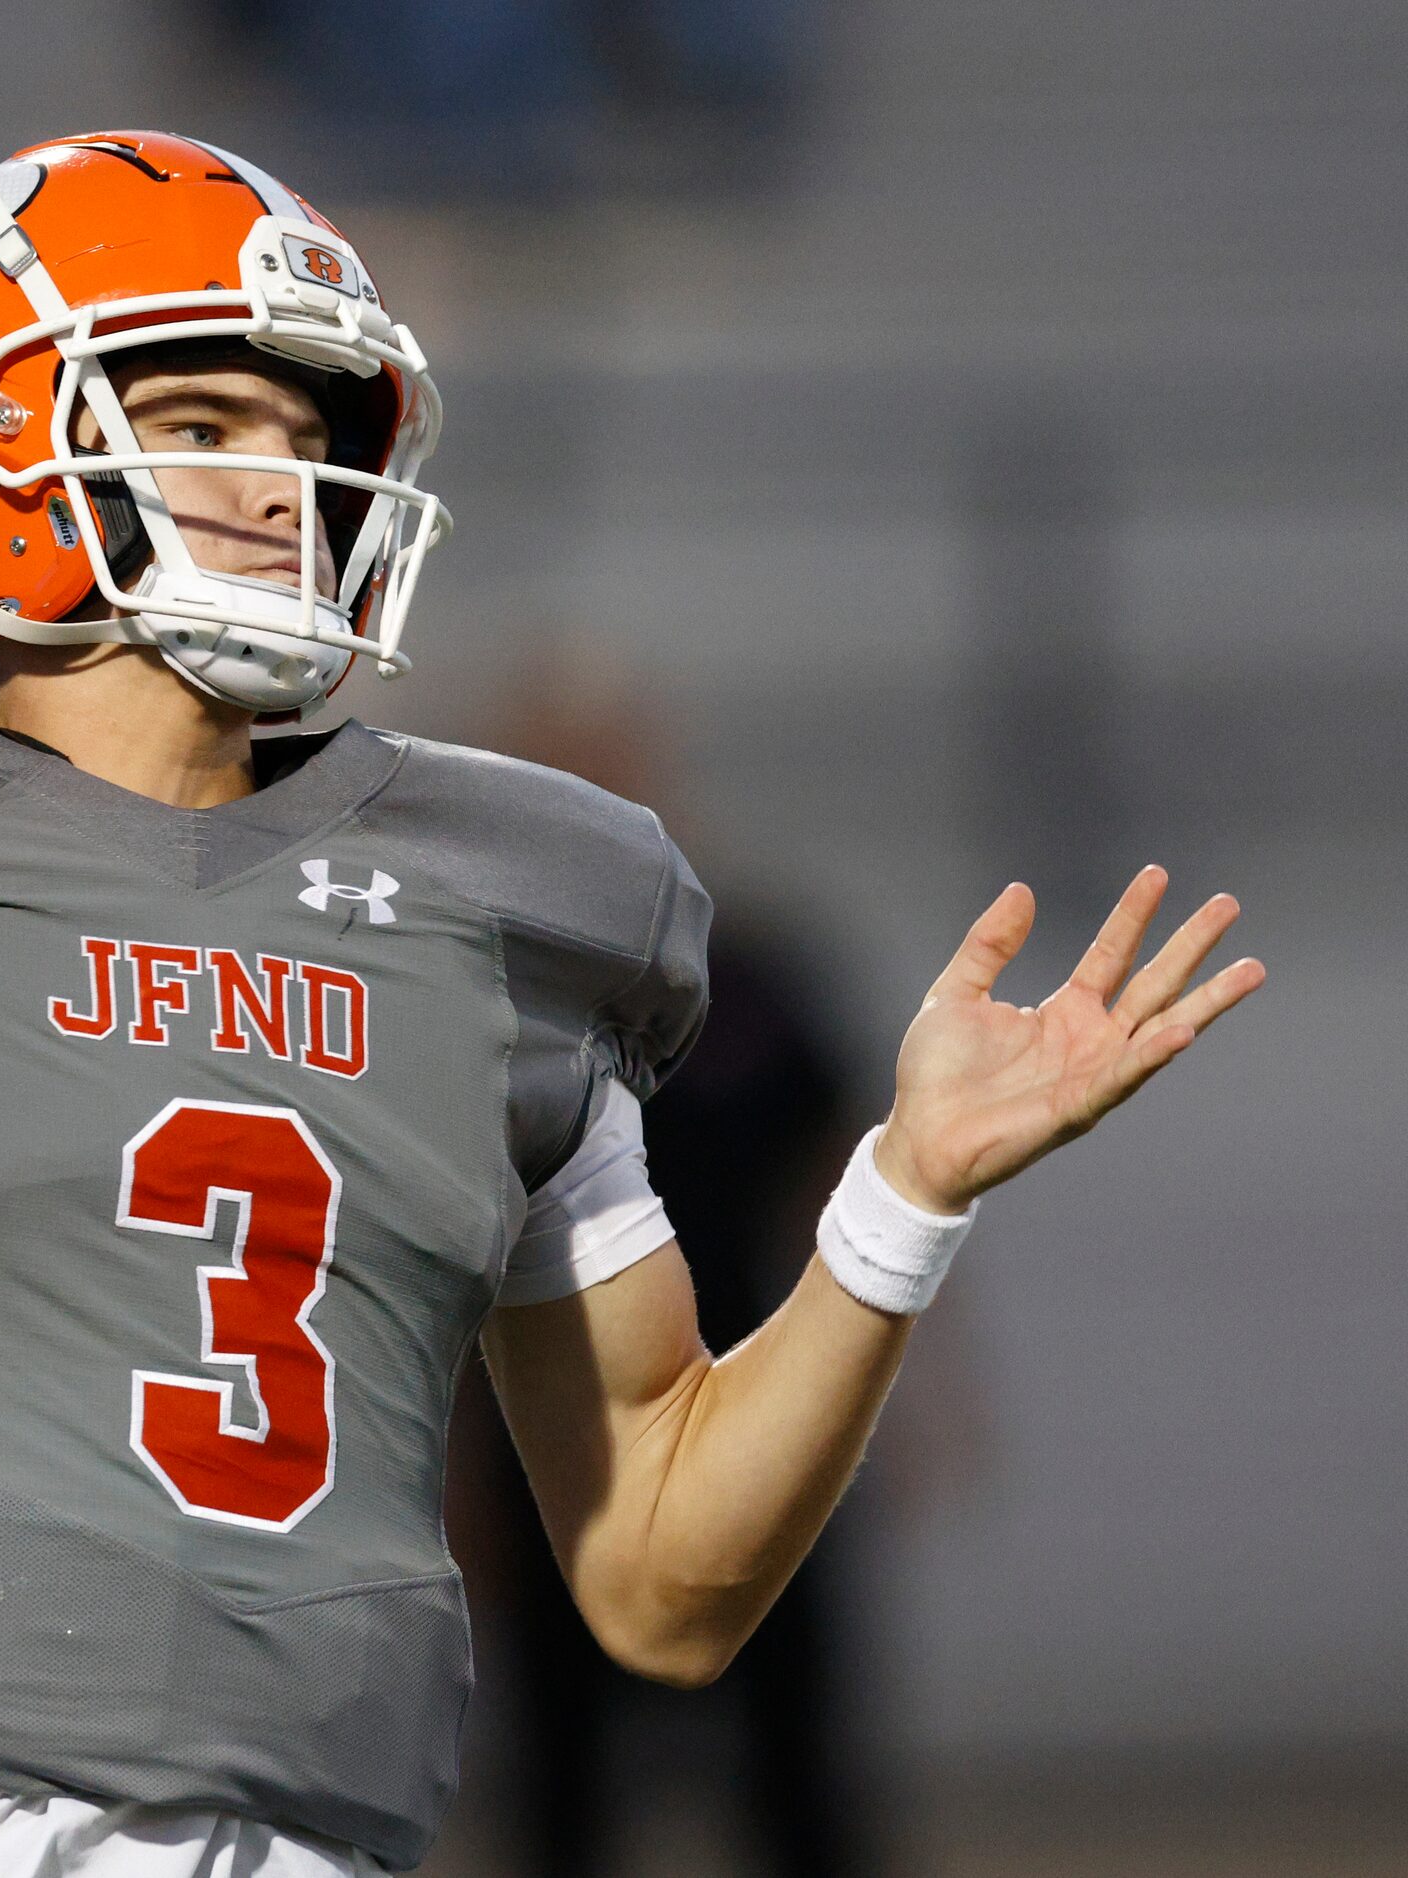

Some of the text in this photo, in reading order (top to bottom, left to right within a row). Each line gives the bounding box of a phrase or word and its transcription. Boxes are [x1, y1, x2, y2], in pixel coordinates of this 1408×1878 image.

[302, 248, 343, 284] R
[51, 503, 75, 545] schutt
[47, 935, 369, 1080] JFND
[115, 1097, 343, 1534] 3
